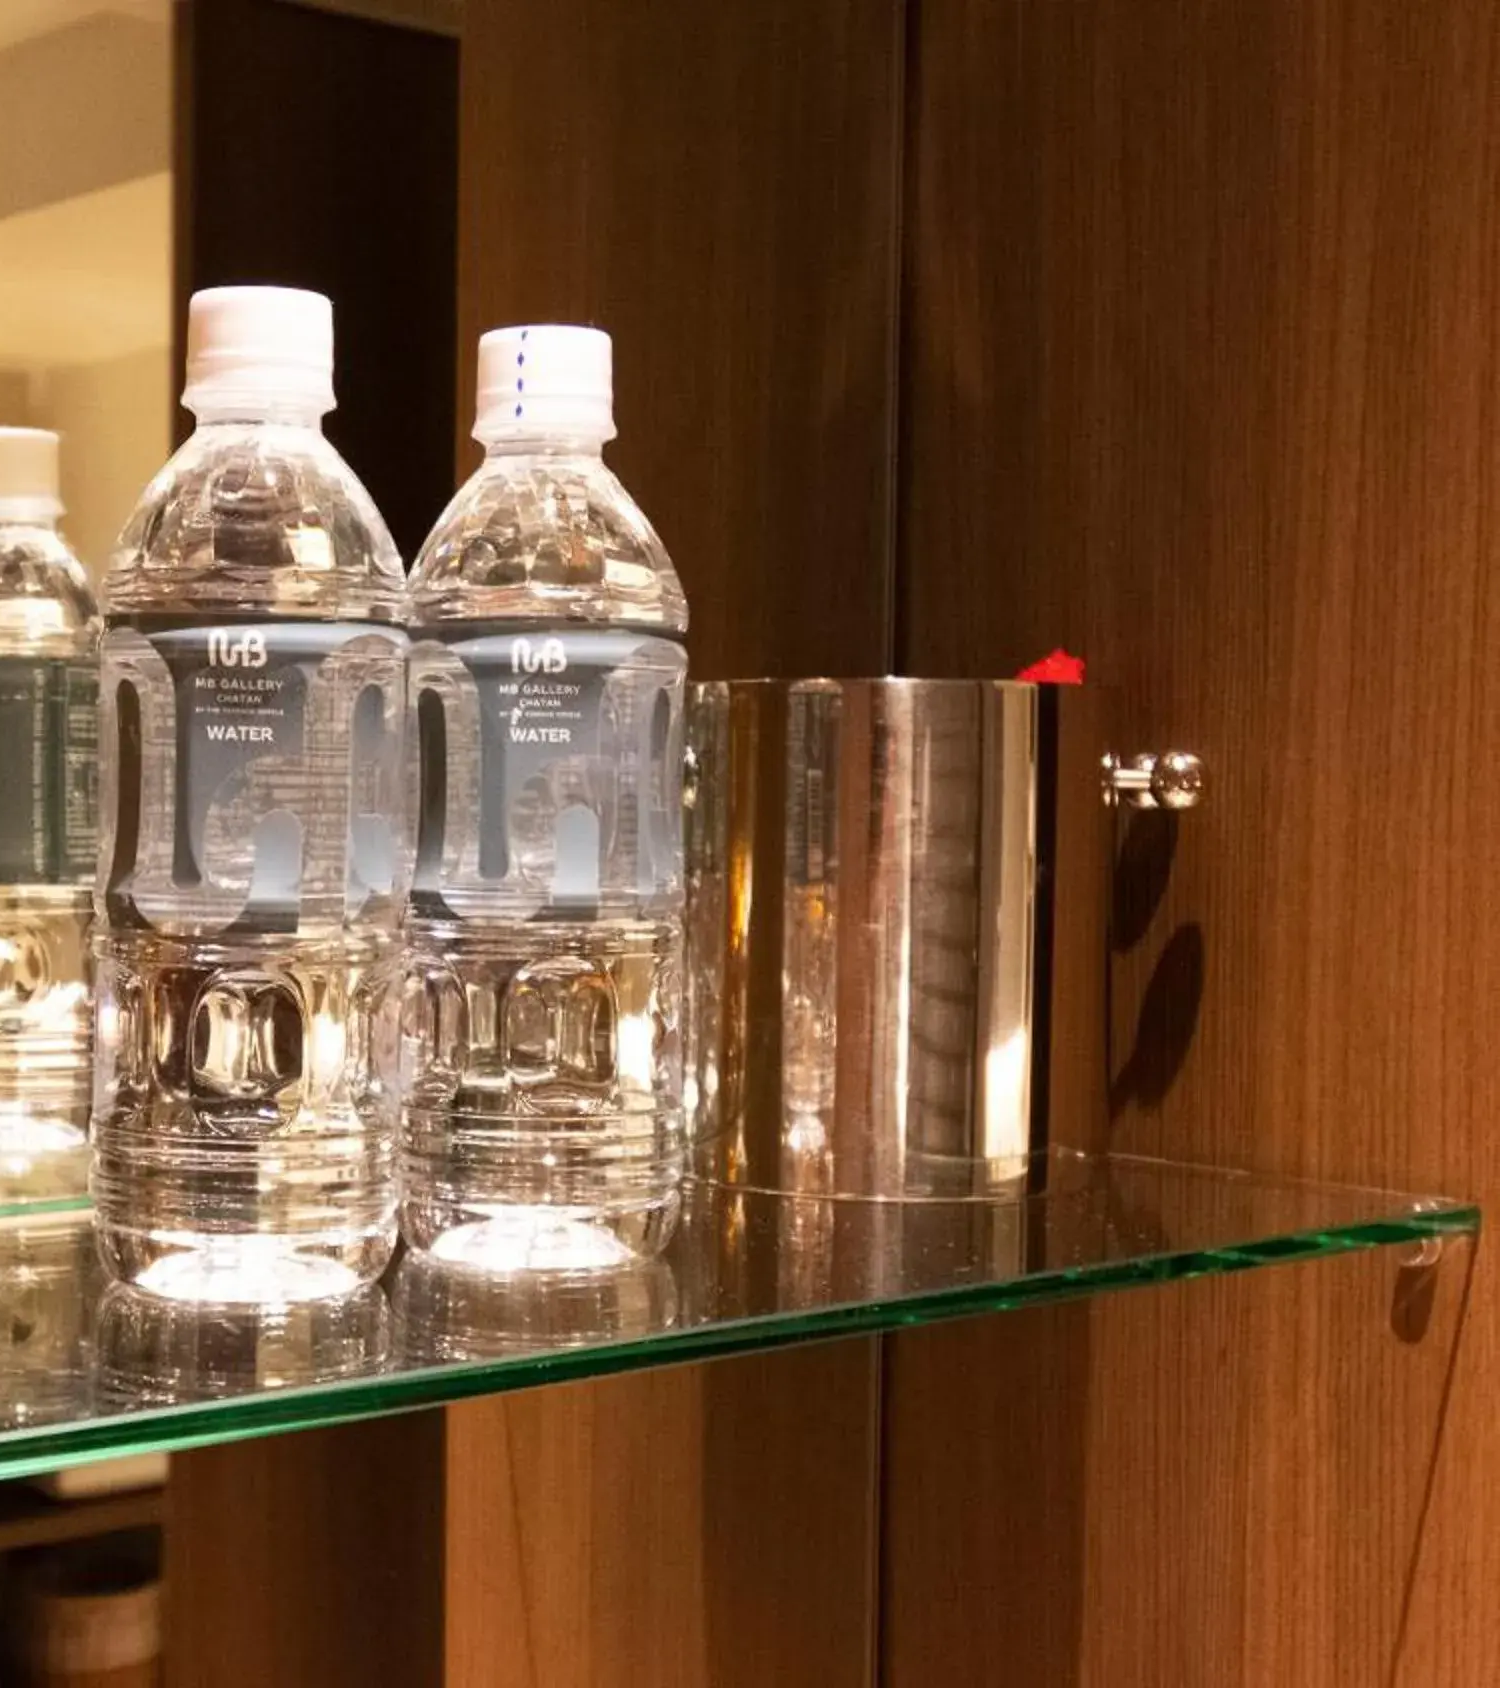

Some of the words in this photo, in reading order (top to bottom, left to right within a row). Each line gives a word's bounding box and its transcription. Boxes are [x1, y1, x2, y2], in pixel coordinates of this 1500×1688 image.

[195, 677, 215, 689] MB
[220, 678, 284, 691] GALLERY
[499, 684, 518, 694] MB
[523, 684, 580, 696] GALLERY
[206, 725, 274, 741] WATER
[510, 728, 571, 742] WATER
